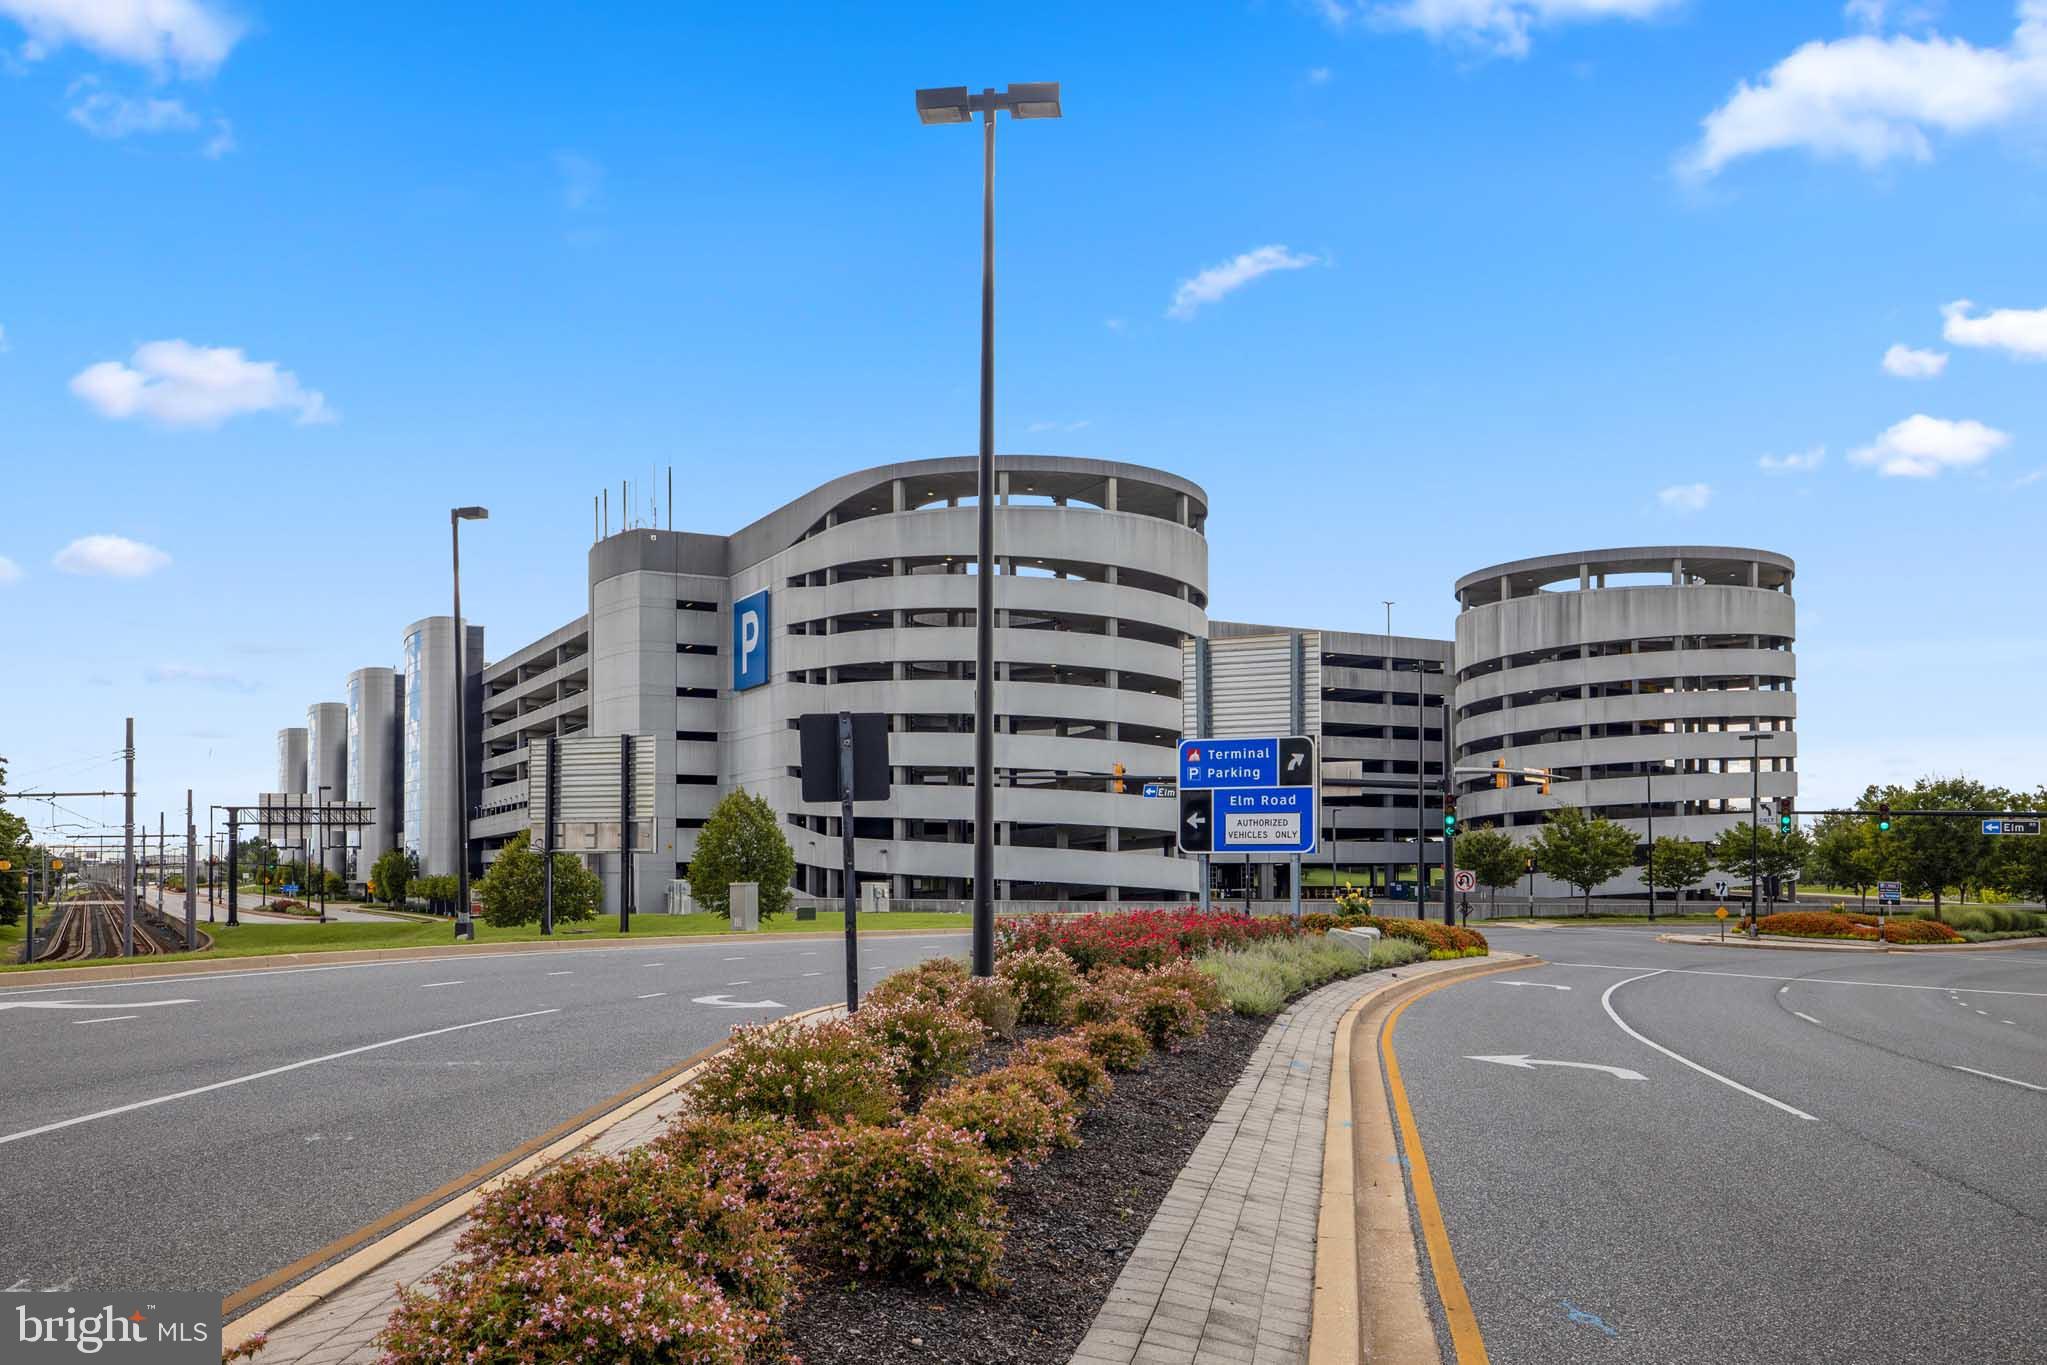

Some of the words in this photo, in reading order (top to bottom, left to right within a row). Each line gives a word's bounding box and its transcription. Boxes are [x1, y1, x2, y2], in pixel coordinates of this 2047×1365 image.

[742, 610, 759, 675] P
[1208, 747, 1270, 760] Terminal
[1208, 766, 1260, 780] Parking
[1158, 788, 1175, 797] Elm
[1230, 795, 1255, 806] Elm
[1261, 794, 1296, 806] Road
[1237, 819, 1289, 827] AUTHORIZED
[2003, 823, 2025, 832] Elm
[1228, 831, 1268, 839] VEHICLES
[1275, 831, 1298, 839] ONLY
